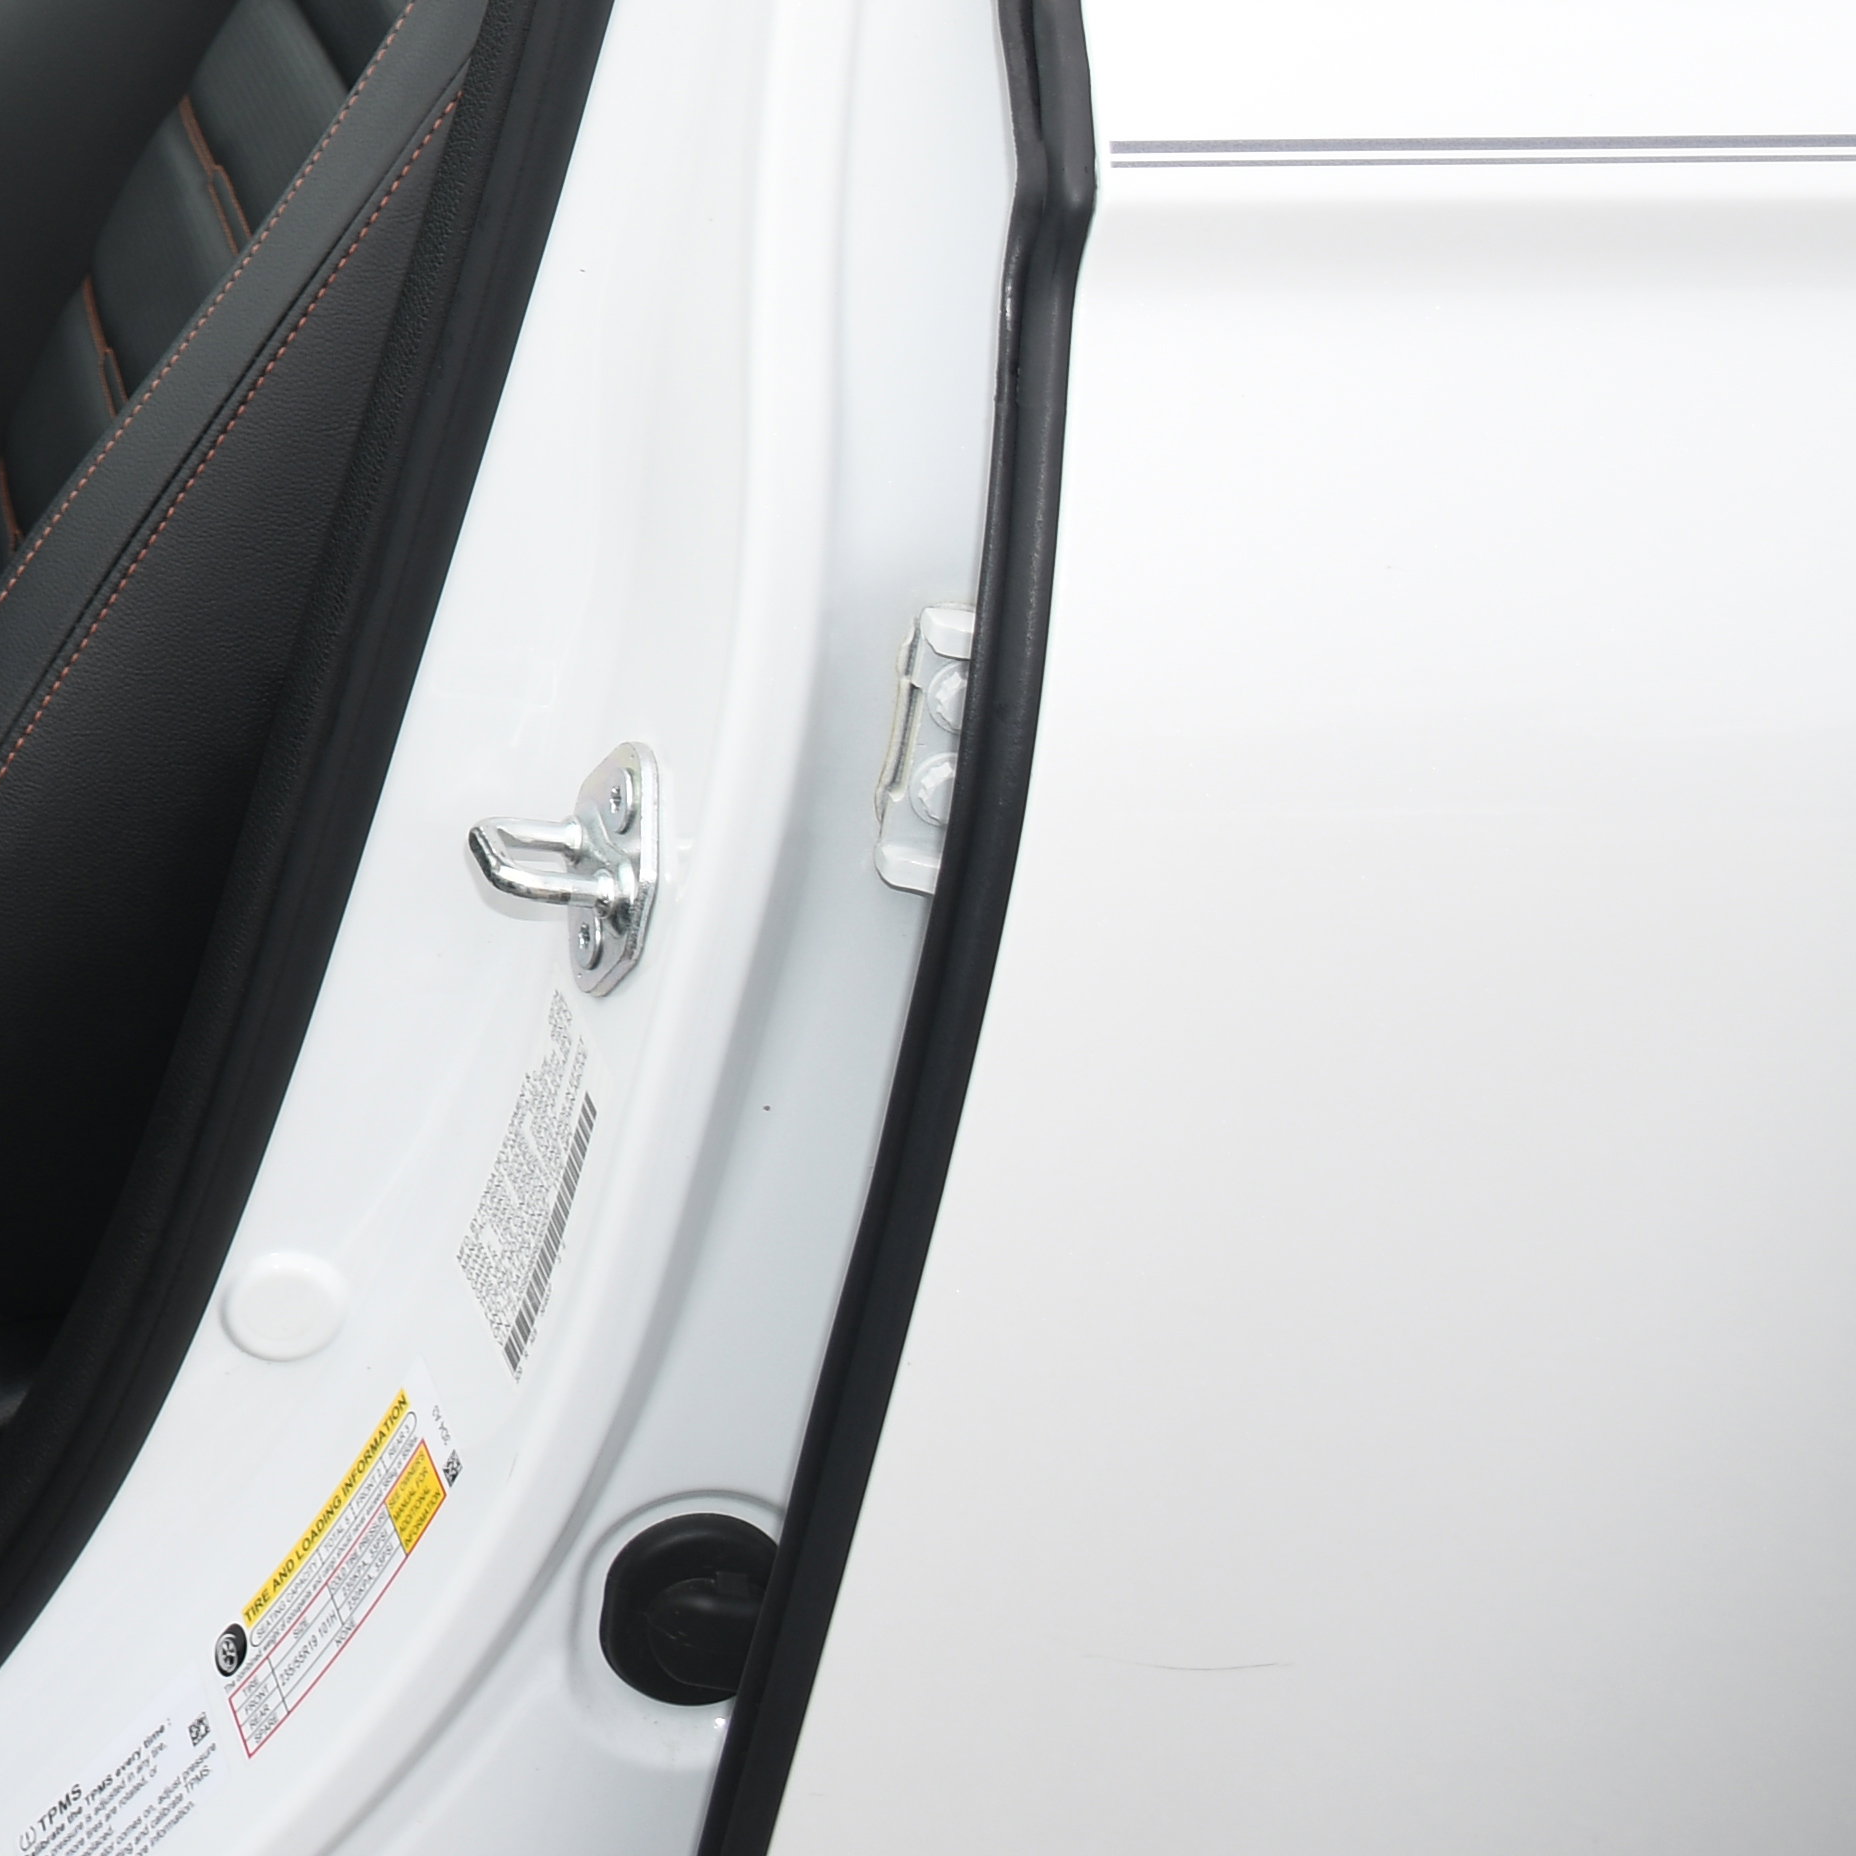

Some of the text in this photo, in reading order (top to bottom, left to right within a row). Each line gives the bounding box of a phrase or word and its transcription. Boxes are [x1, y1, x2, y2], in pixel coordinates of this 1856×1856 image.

[388, 1431, 405, 1458] REAR
[356, 1476, 376, 1507] FRONT
[244, 1395, 407, 1622] TIRE AND LOADING INFORMATION
[324, 1528, 345, 1552] TOTAL
[256, 1562, 317, 1639] SEATING CAPACITY
[293, 1619, 308, 1639] SIZE
[335, 1620, 355, 1647] NONE
[279, 1610, 337, 1687] 235/55R19 101H
[242, 1677, 259, 1696] TIRE
[244, 1685, 268, 1714] FRONT
[249, 1703, 270, 1729] REAR
[254, 1716, 278, 1744] SPARE
[67, 1806, 83, 1824] the
[85, 1774, 113, 1805] TPMS
[115, 1746, 142, 1777] every
[143, 1724, 165, 1748] time
[37, 1784, 82, 1832] TPMS
